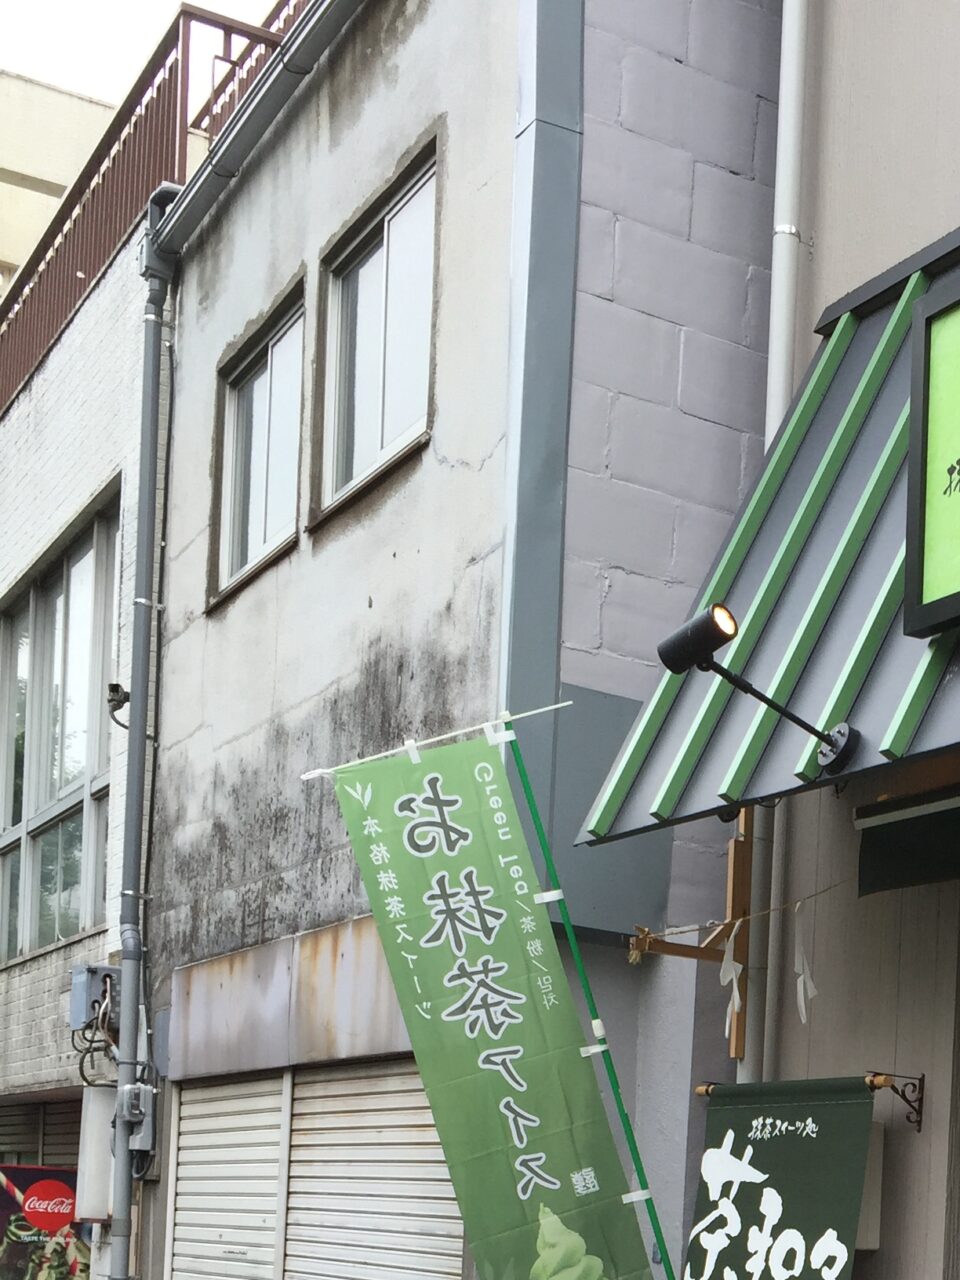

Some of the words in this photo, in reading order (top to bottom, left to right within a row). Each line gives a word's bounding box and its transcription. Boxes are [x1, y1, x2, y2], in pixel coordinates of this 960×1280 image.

[748, 1116, 819, 1141] 抹茶スイーツ処
